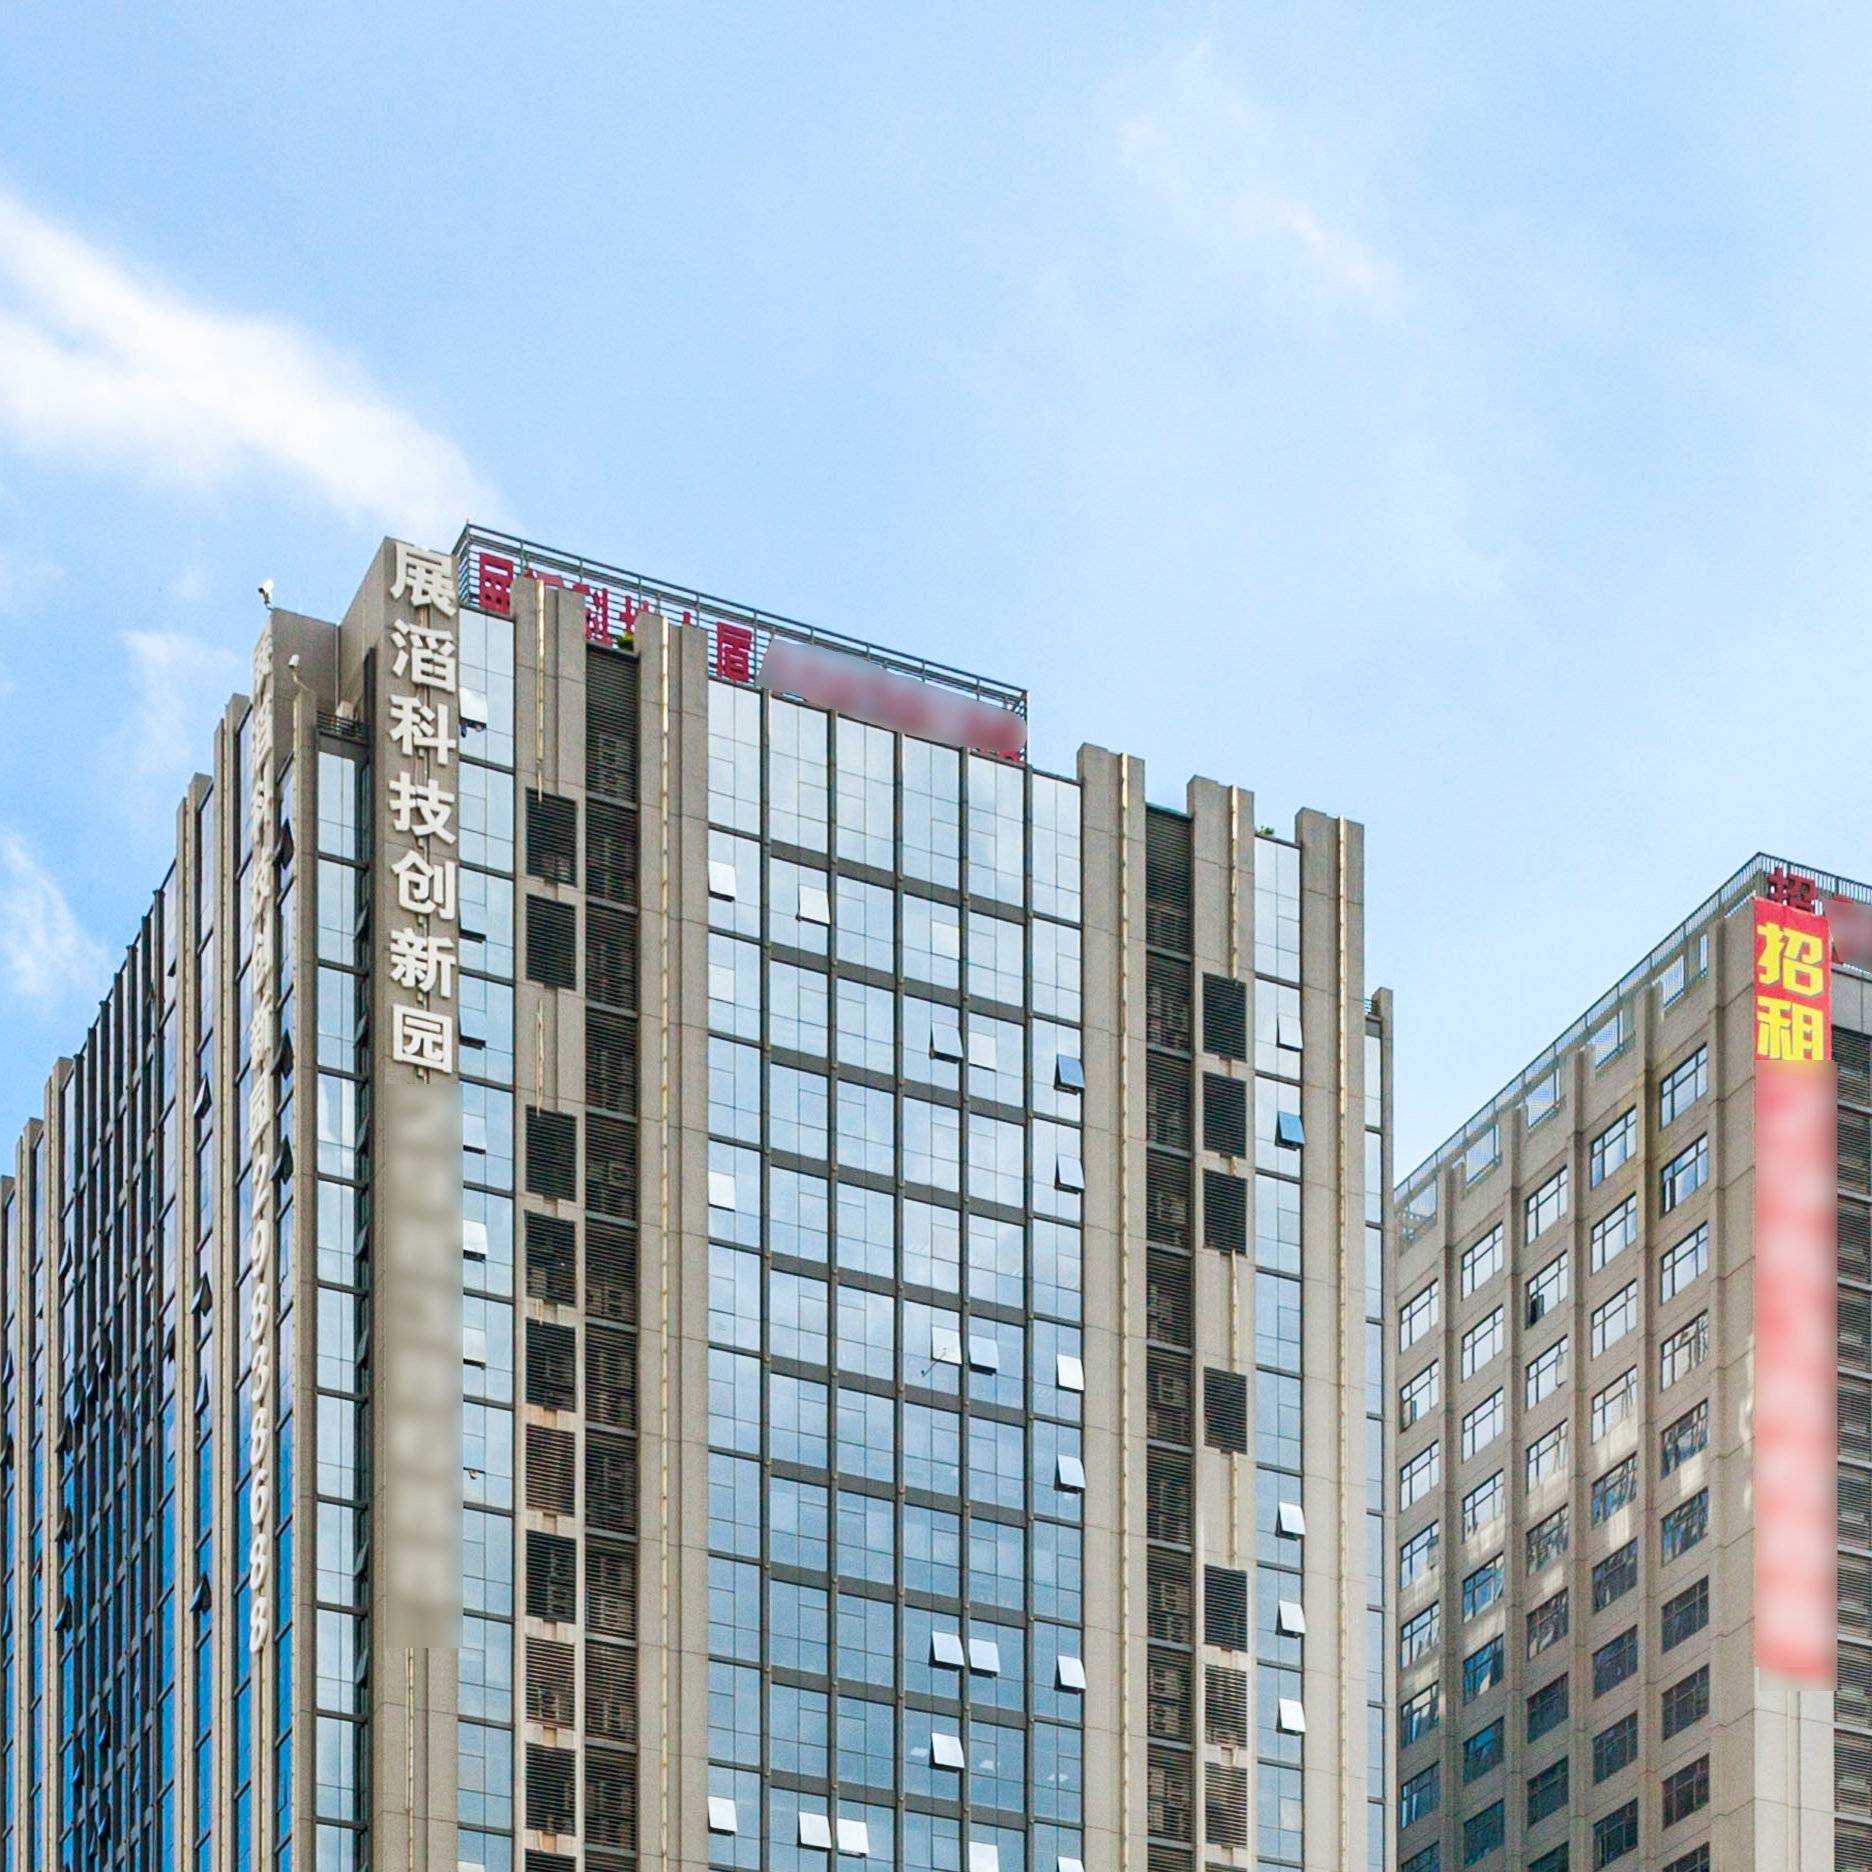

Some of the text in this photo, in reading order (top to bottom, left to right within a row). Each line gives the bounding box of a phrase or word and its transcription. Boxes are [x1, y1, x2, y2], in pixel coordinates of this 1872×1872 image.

[389, 542, 456, 1076] 展滔科技创新园
[1755, 921, 1825, 1061] 招租
